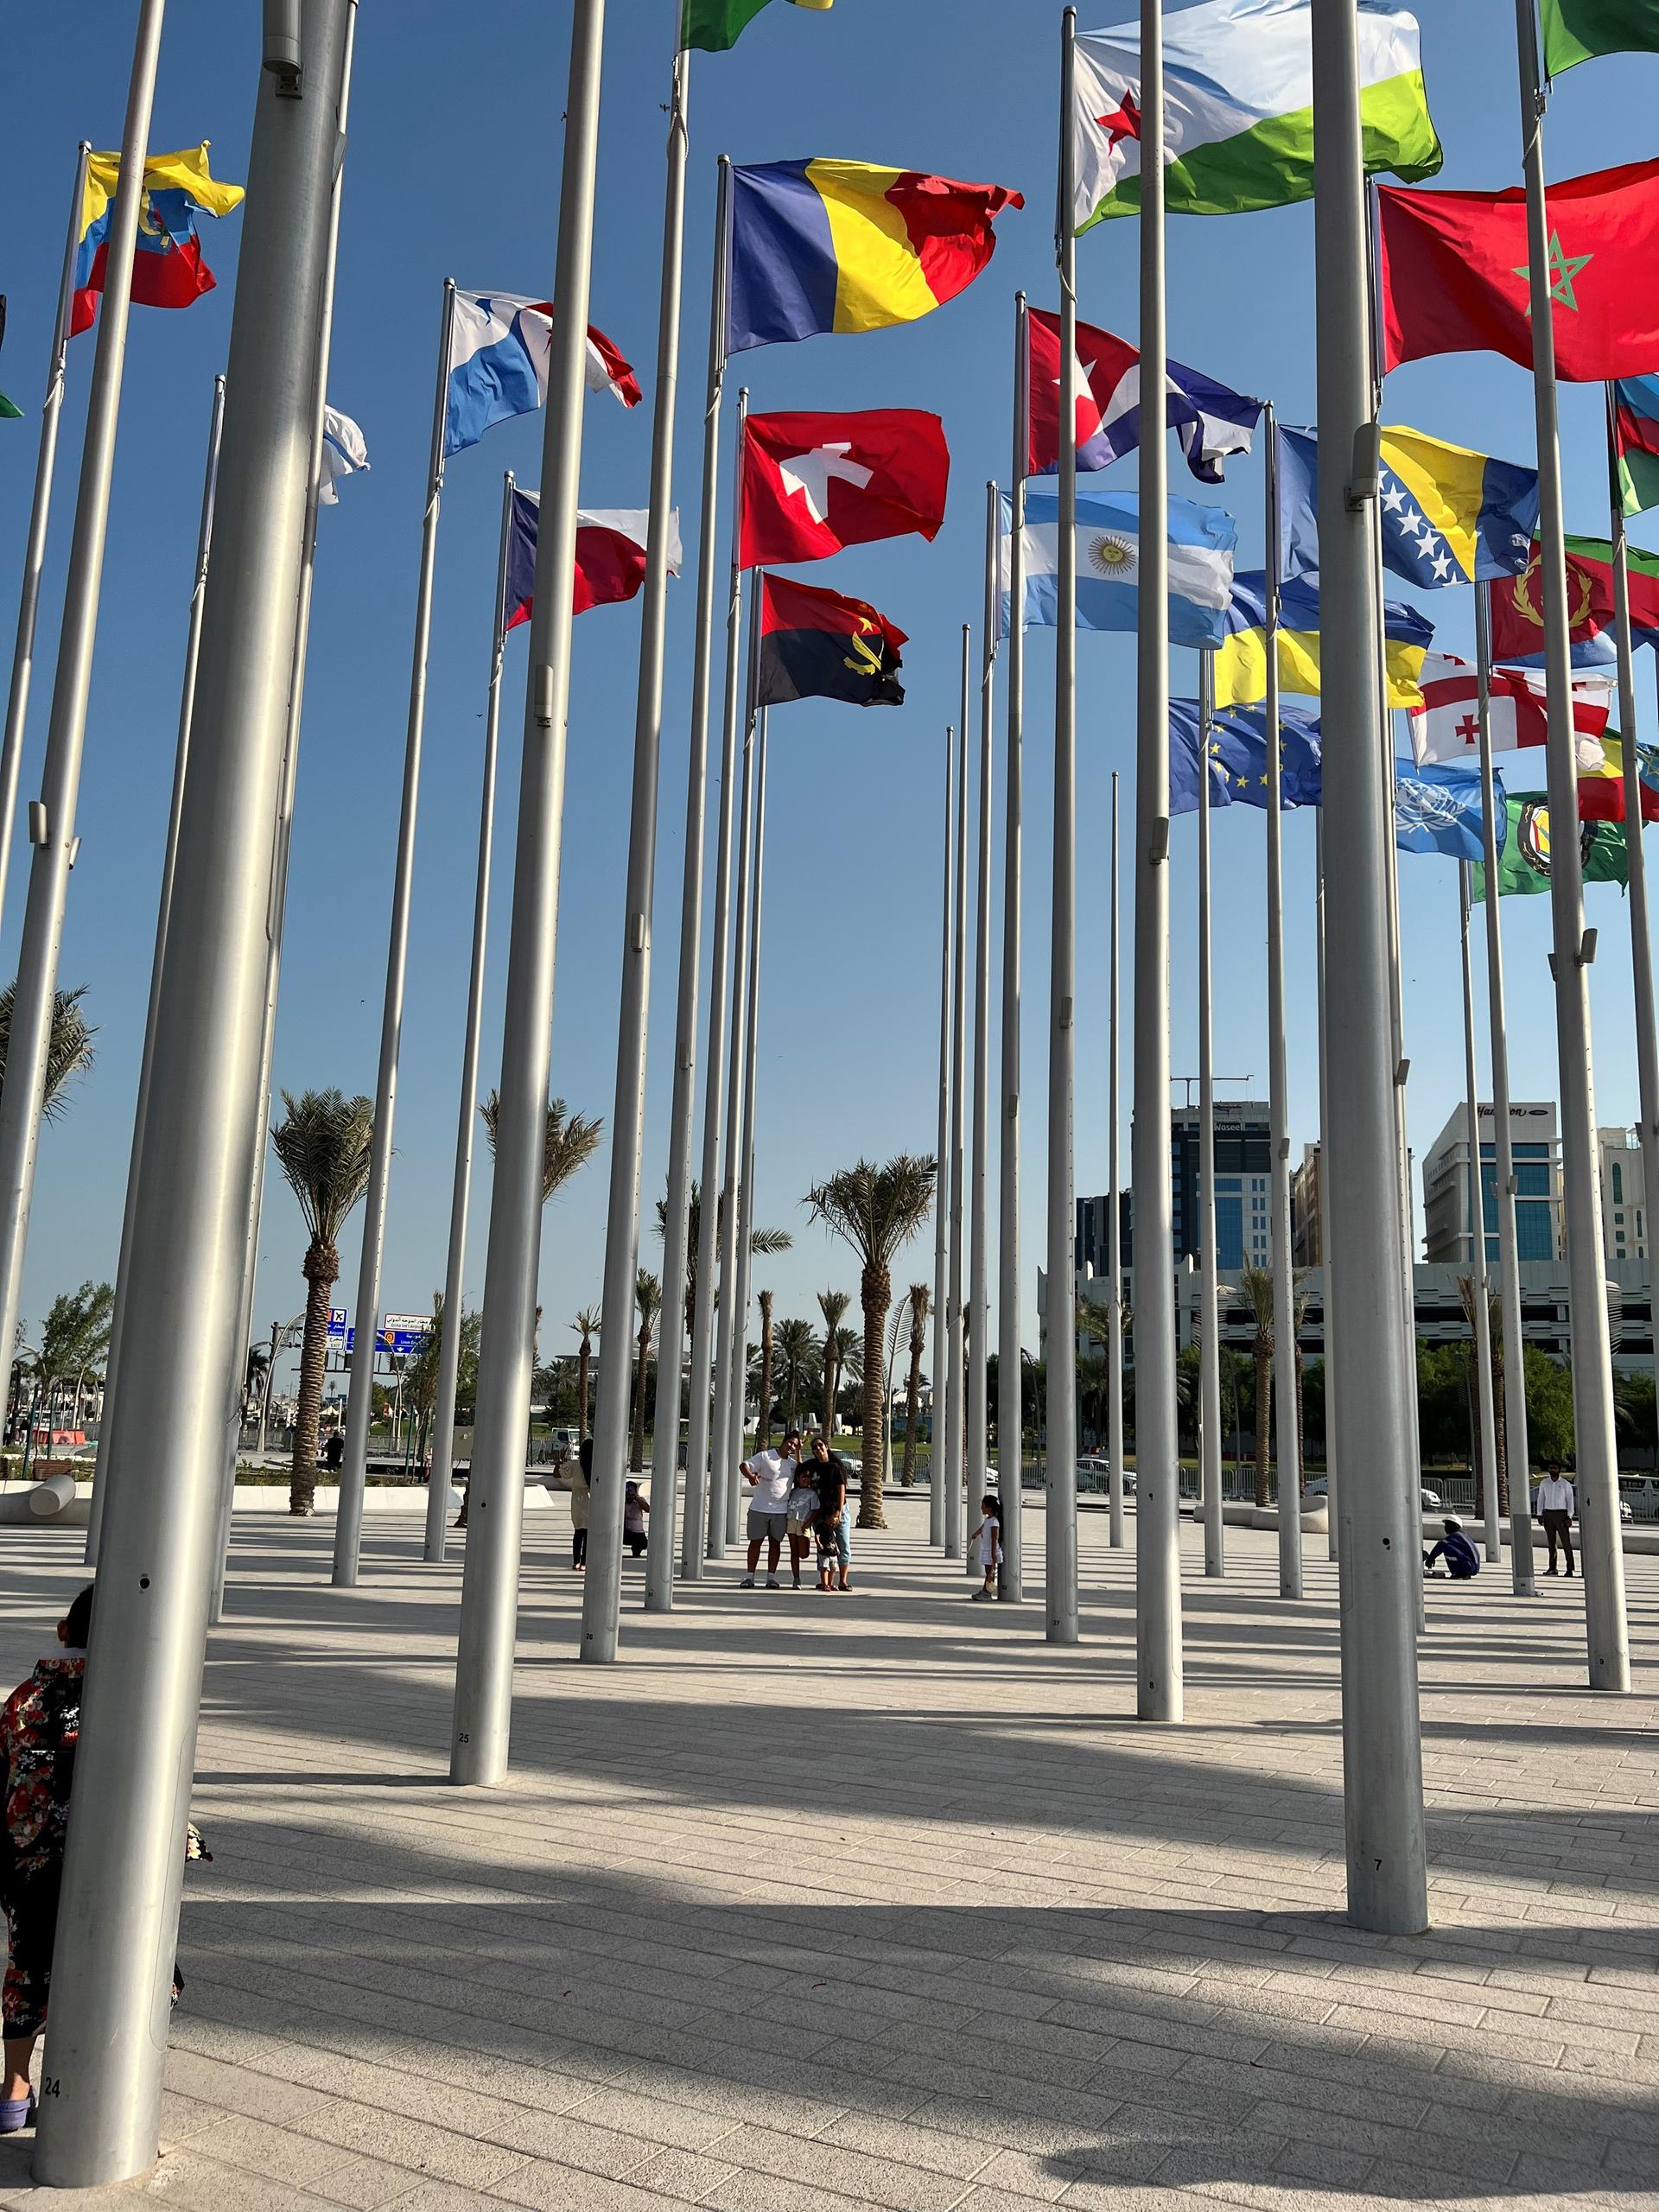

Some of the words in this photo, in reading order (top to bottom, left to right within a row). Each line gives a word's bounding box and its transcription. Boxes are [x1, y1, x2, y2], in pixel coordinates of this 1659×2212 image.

[1478, 1106, 1527, 1118] Haon
[1149, 1681, 1154, 1689] 8
[1374, 1859, 1382, 1872] 7
[45, 2076, 60, 2098] 24
